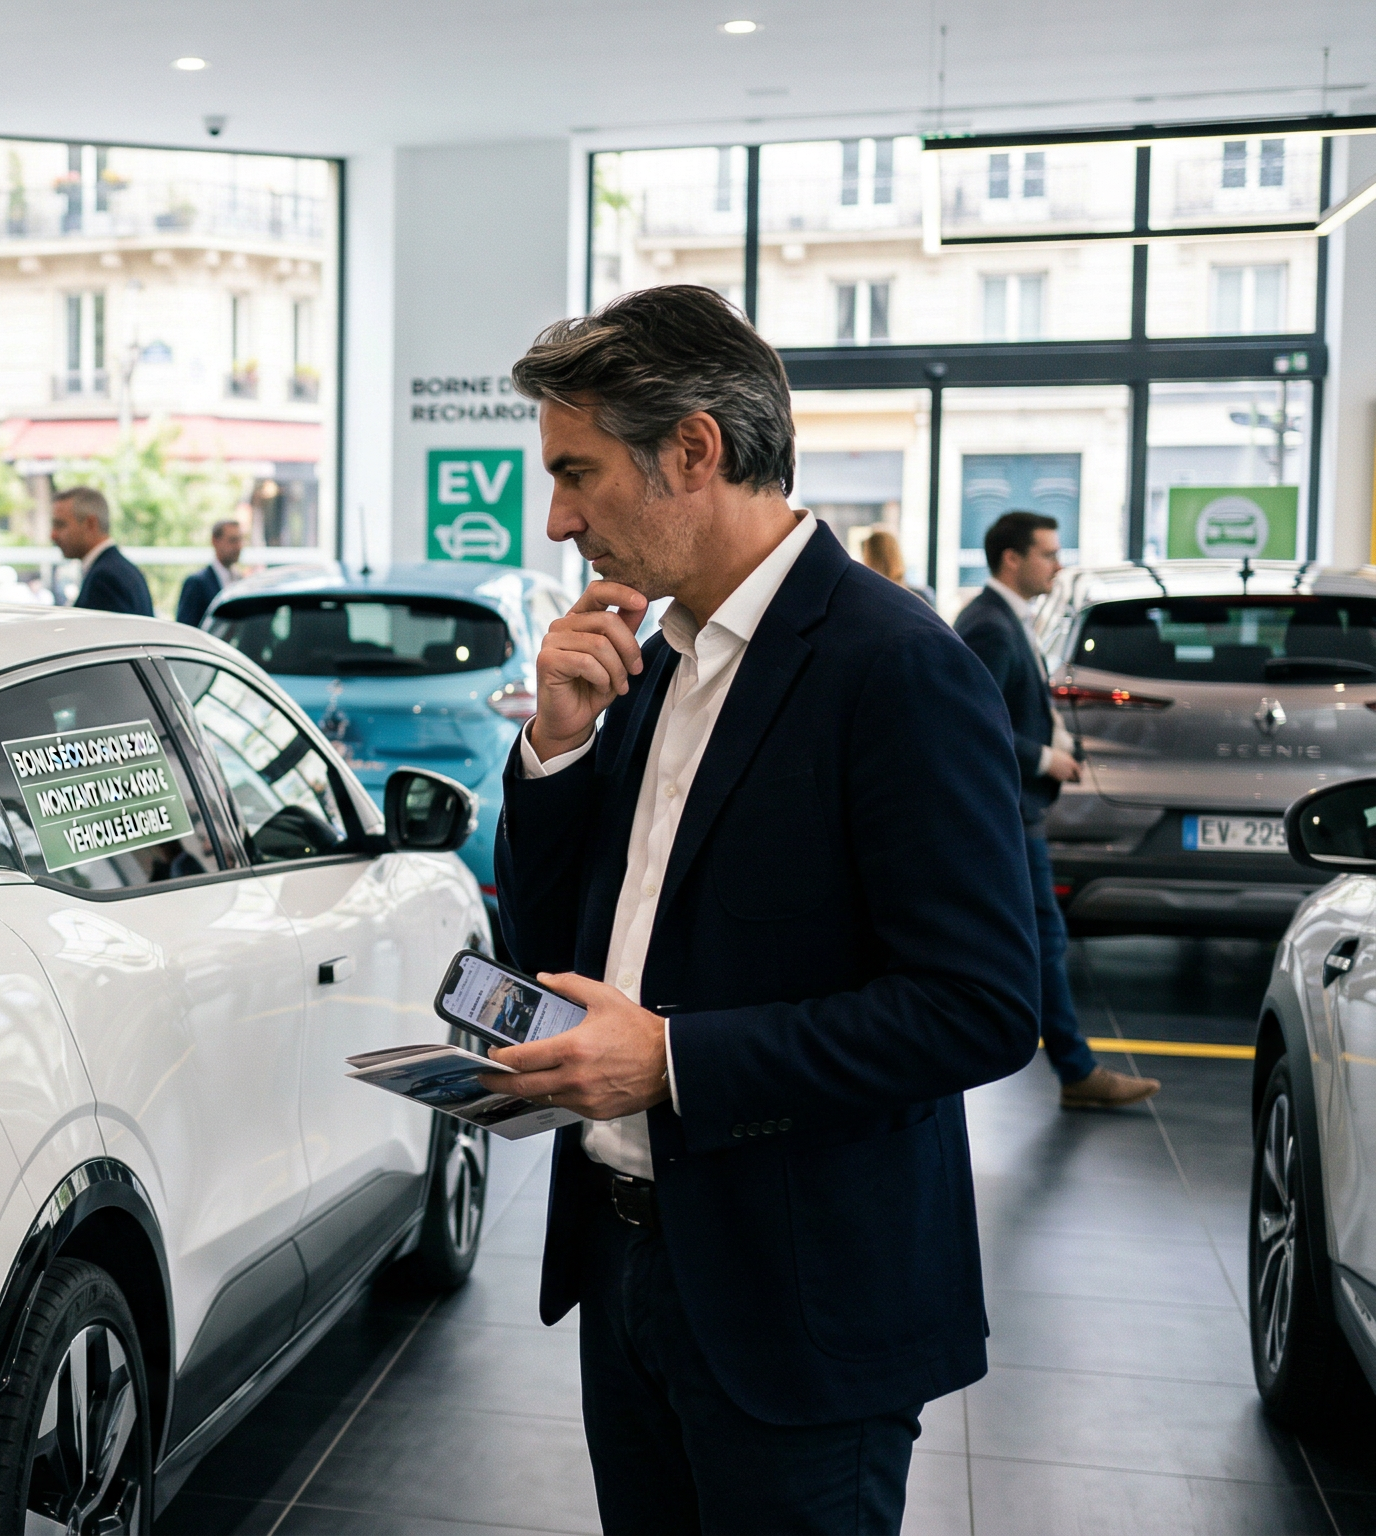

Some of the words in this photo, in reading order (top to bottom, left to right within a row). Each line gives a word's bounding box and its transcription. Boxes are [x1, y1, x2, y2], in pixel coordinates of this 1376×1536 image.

[411, 378, 491, 395] BORNE
[438, 460, 513, 504] EV
[12, 745, 63, 778] BONUS
[36, 781, 99, 818] MONTANT
[63, 817, 126, 854] VÉHICULE
